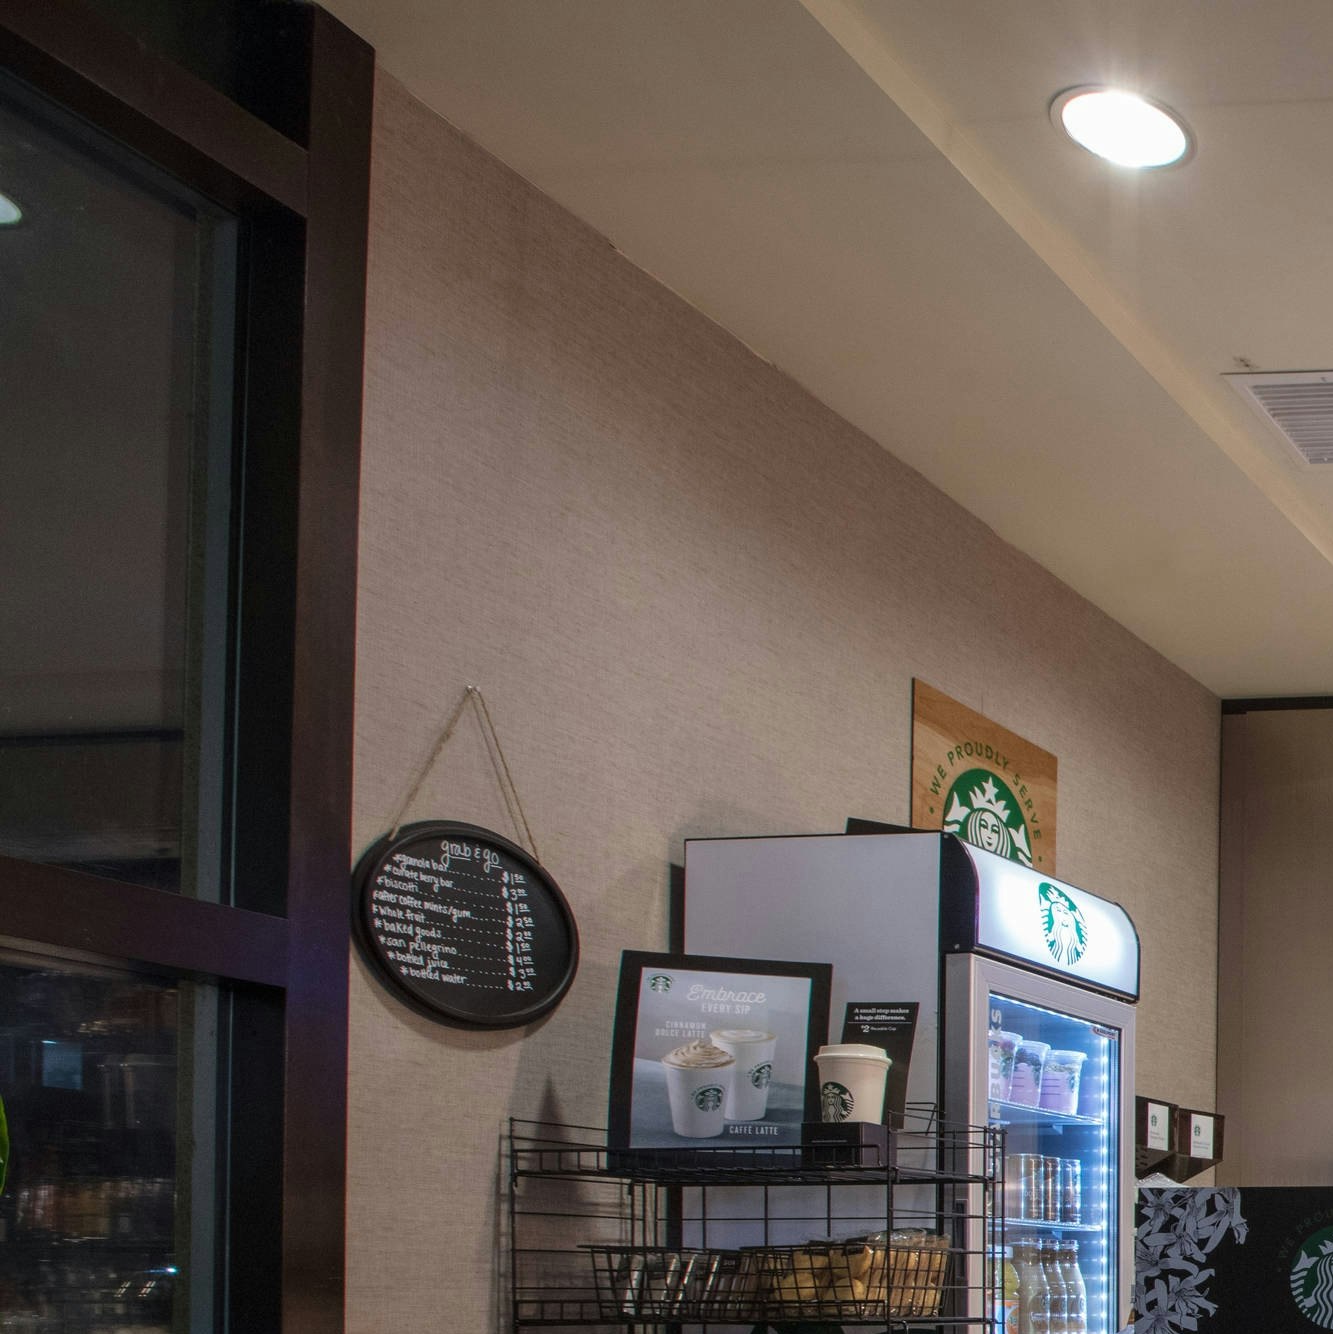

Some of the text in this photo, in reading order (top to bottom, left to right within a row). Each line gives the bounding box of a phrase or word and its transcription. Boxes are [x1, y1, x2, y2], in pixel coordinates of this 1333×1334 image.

[930, 741, 1042, 840] WE PROUDLY SERVE
[440, 840, 471, 866] grab
[483, 849, 500, 874] go
[687, 984, 768, 1003] Embrace
[702, 1003, 751, 1015] EVERY SIP
[755, 1126, 779, 1135] LATTE
